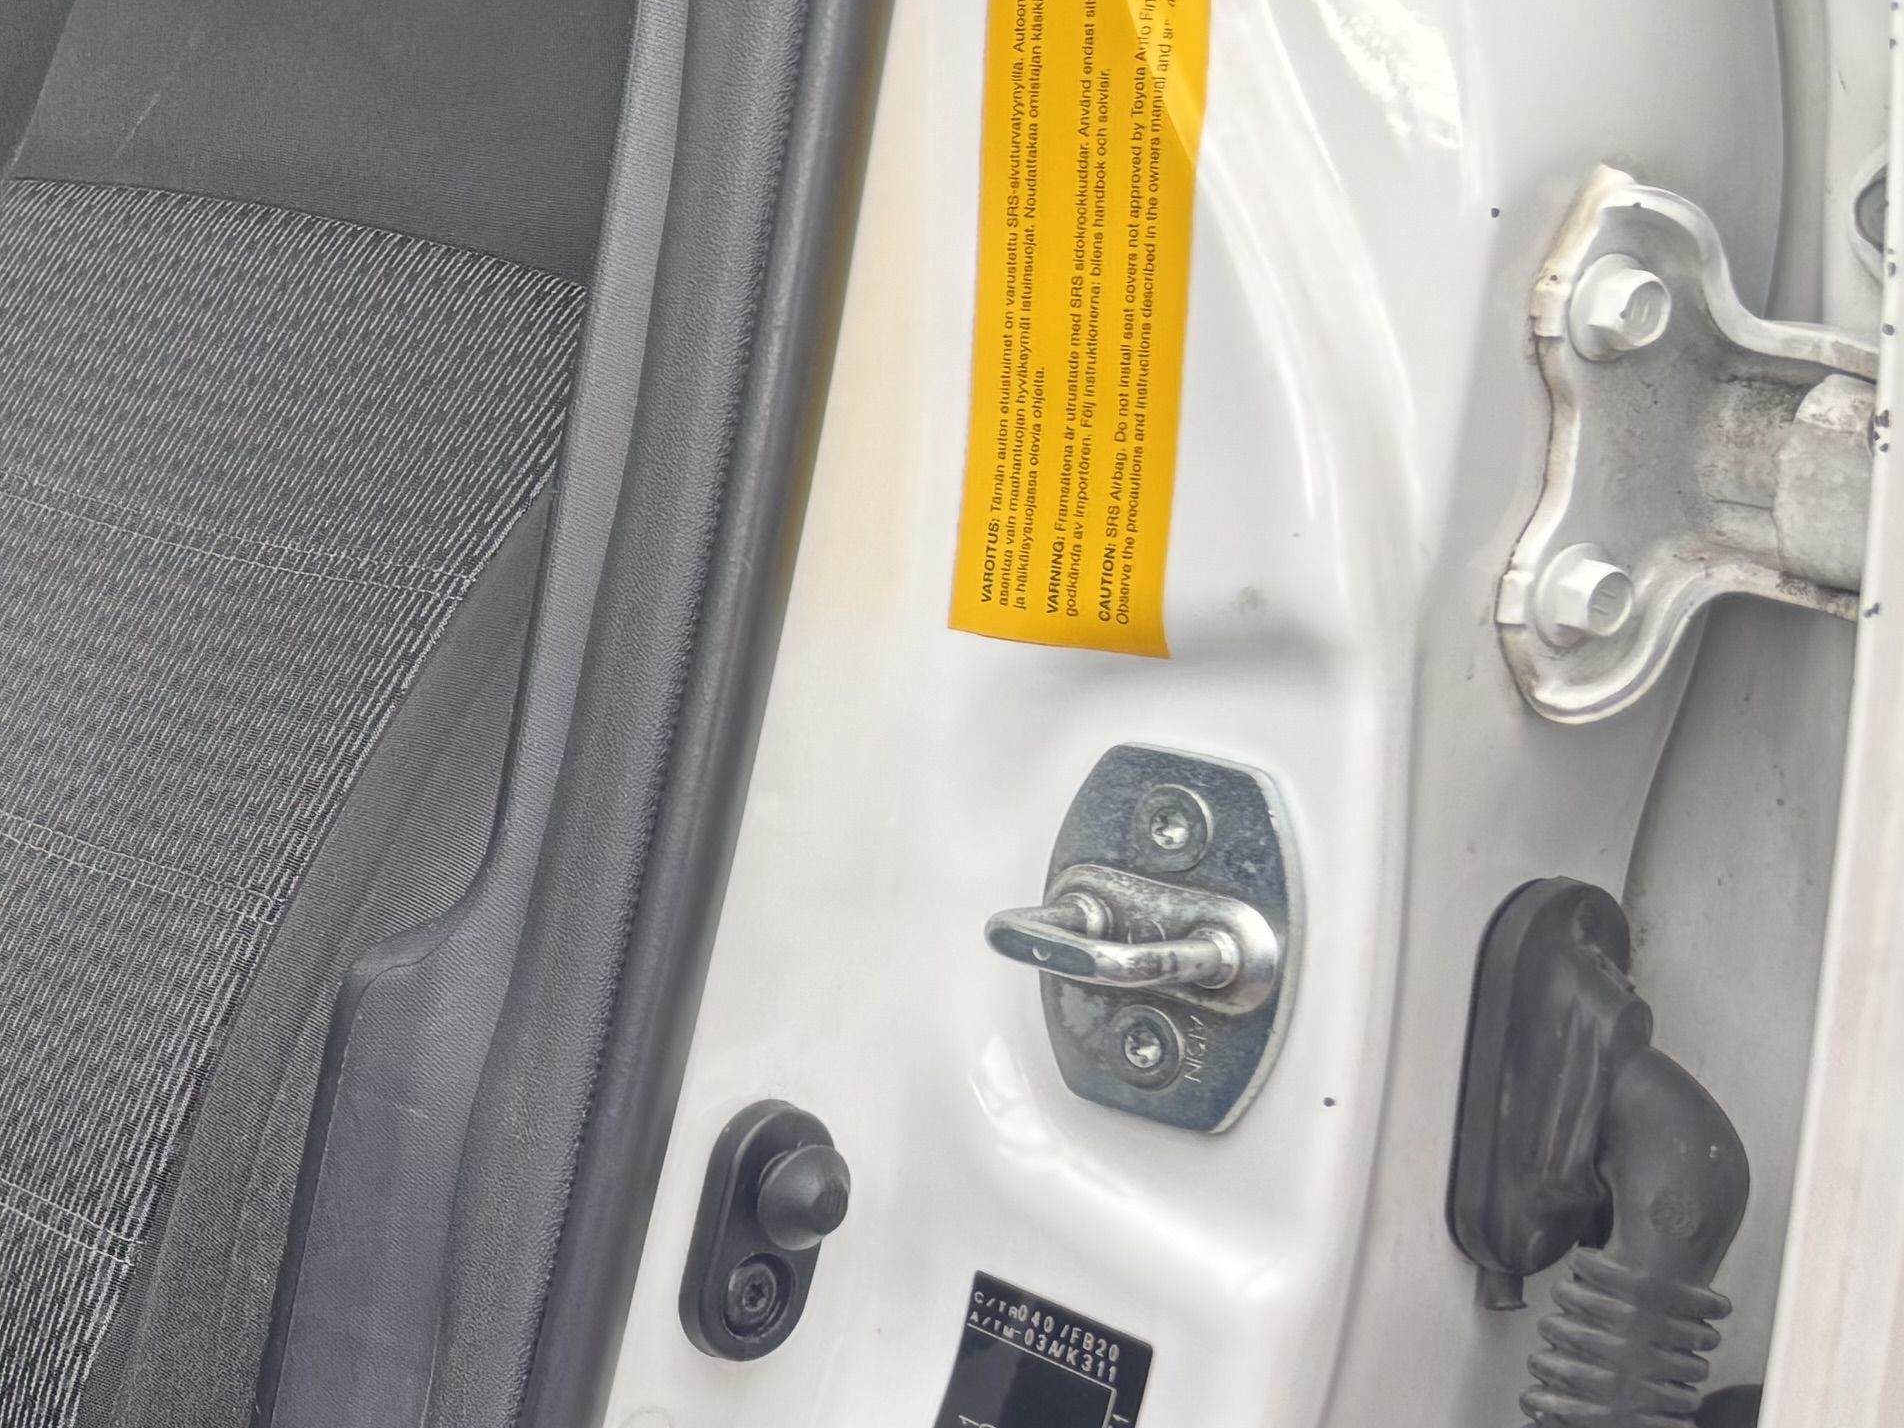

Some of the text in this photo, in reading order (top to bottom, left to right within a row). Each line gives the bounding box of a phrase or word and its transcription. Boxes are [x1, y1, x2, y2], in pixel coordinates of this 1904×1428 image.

[1079, 22, 1095, 74] endast
[1155, 42, 1171, 71] and
[1026, 44, 1044, 117] omistajan
[1130, 65, 1148, 118] Toyota
[1076, 78, 1093, 137] Använd
[1130, 122, 1145, 141] by
[1094, 126, 1108, 156] och
[1147, 136, 1161, 193] owners
[1023, 122, 1041, 218] Noudattakaa
[1090, 160, 1107, 227] handbok
[1126, 145, 1146, 219] approved
[1144, 224, 1156, 238] in
[1145, 196, 1158, 221] the
[1089, 231, 1103, 276] bilens
[1125, 222, 1139, 248] not
[1003, 232, 1019, 305] varustettu
[1018, 224, 1037, 311] istuinsuojat.
[1069, 275, 1083, 308] SRS
[1124, 251, 1137, 303] covers
[1138, 242, 1156, 318] described
[1004, 310, 1014, 329] on
[1067, 313, 1081, 346] med
[1082, 280, 1102, 397] instruktionerna:
[1121, 308, 1134, 340] seat
[997, 334, 1014, 414] etuistuimet
[1015, 316, 1033, 404] hyväksymät
[1118, 344, 1132, 387] install
[1133, 321, 1151, 409] instructions
[1031, 365, 1047, 419] ohjeita.
[1116, 391, 1129, 417] not
[996, 418, 1009, 459] auton
[1028, 422, 1041, 465] olevia
[1063, 425, 1074, 440] är
[1114, 420, 1127, 442] Do
[1132, 412, 1145, 441] and
[1007, 407, 1026, 511] maahantuojan
[1109, 446, 1127, 501] Airbag.
[989, 464, 1005, 513] Tämän
[1054, 443, 1073, 531] Framsätena
[1125, 445, 1144, 533] precautions
[1005, 515, 1017, 545] vain
[1074, 522, 1084, 540] av
[1105, 504, 1120, 538] SRS
[980, 517, 1000, 603] VAROITUS:
[1122, 536, 1134, 560] the
[999, 549, 1013, 606] asentaa
[1046, 535, 1065, 614] VARNING:
[1064, 542, 1083, 617] godkända
[1097, 542, 1117, 622] CAUTION:
[1115, 563, 1133, 624] Observe
[1013, 595, 1026, 610] ja
